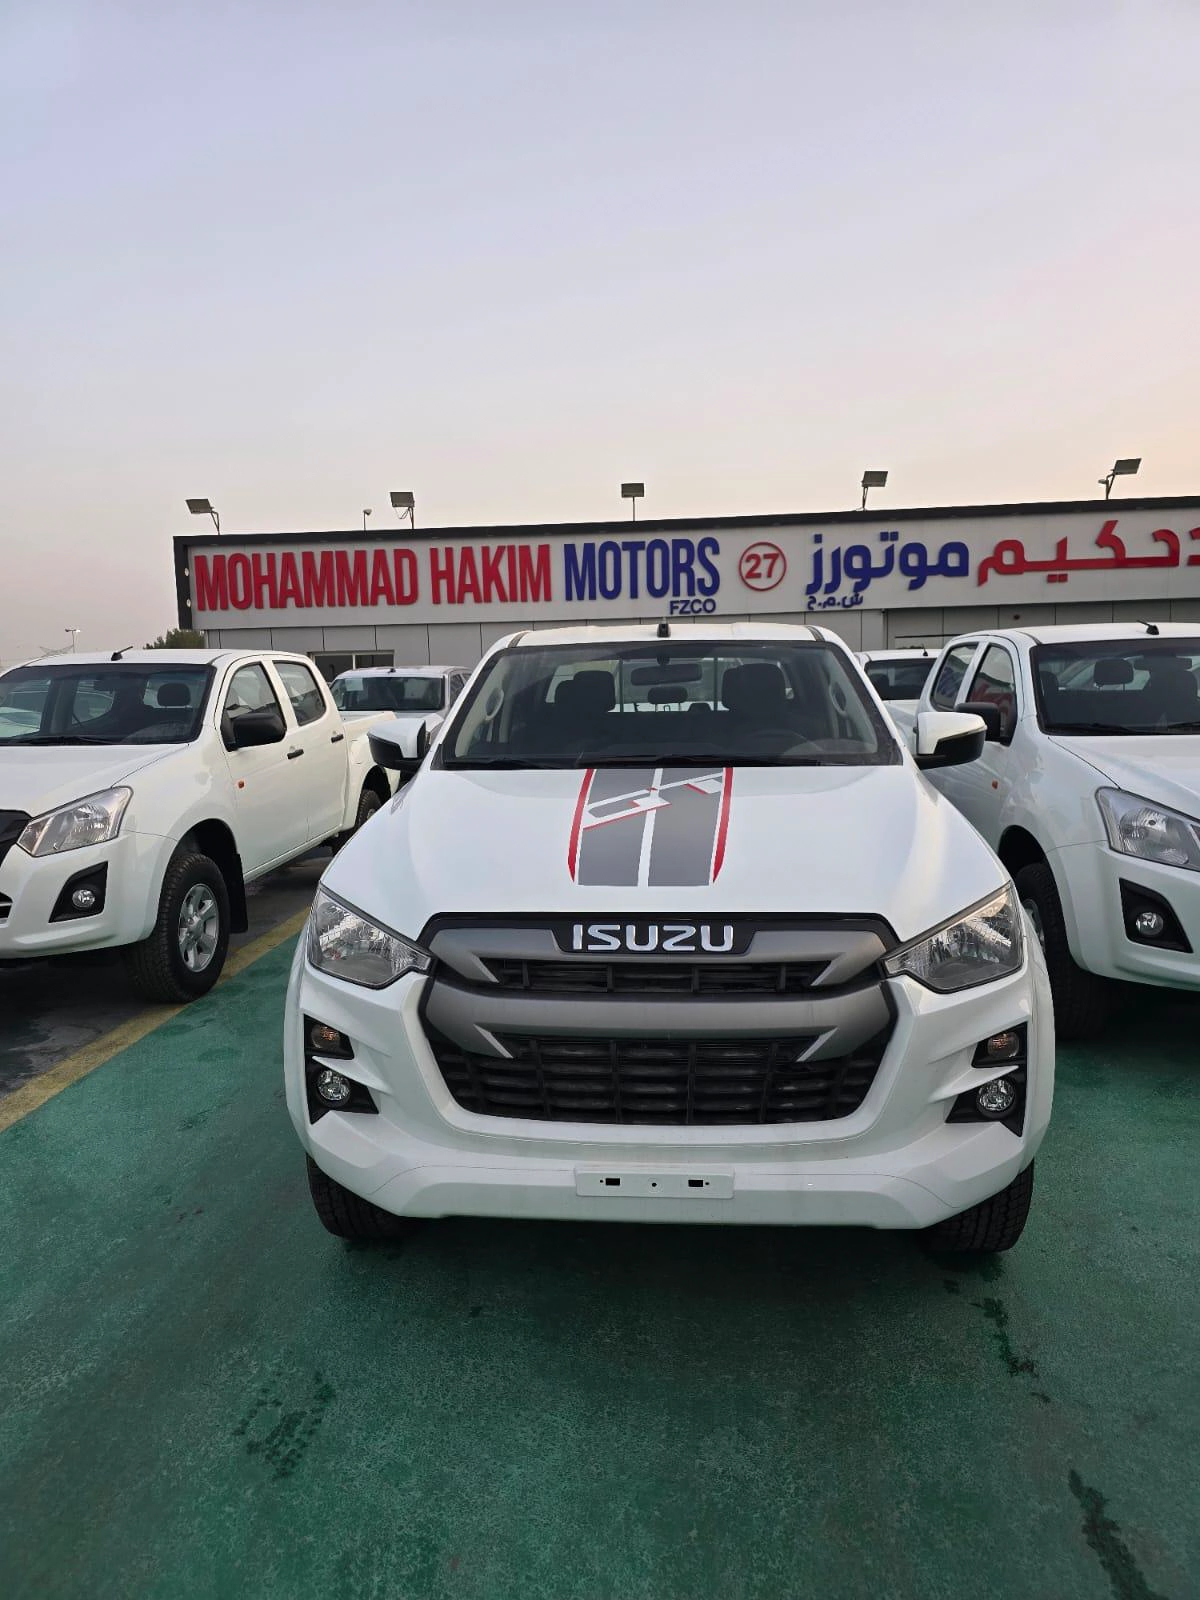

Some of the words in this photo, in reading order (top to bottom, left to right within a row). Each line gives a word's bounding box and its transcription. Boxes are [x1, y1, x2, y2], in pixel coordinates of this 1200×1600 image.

[193, 548, 418, 612] MOHAMMAD
[430, 543, 553, 605] HAKIM
[564, 536, 720, 599] MOTORS
[744, 552, 780, 580] 27
[805, 531, 970, 596] موتورز
[977, 519, 1181, 588] حكيم
[669, 598, 717, 615] FZCO
[572, 923, 735, 953] ISUZU
